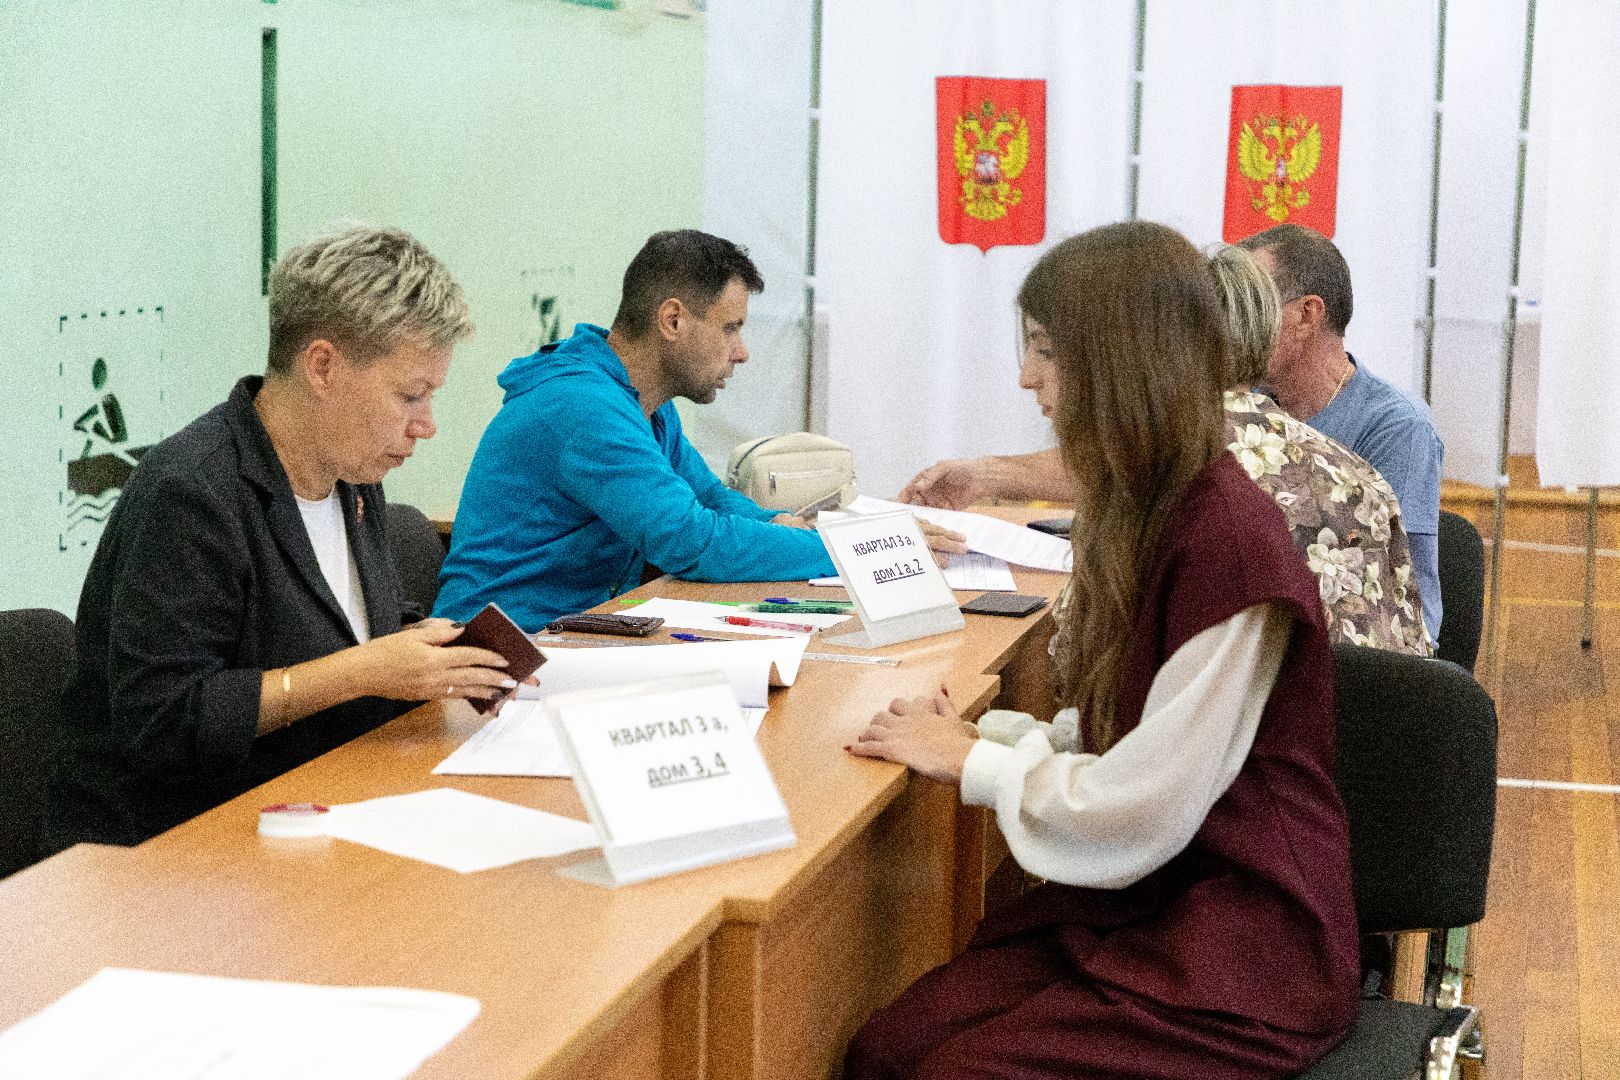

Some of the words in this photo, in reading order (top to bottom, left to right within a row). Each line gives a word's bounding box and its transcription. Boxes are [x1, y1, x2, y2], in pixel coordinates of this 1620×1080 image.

[852, 536, 897, 556] КВАРТАЛ
[896, 534, 905, 547] 3
[913, 558, 924, 572] 2
[608, 717, 694, 747] КВАРТАЛ
[695, 715, 708, 733] 3
[713, 751, 728, 772] 4
